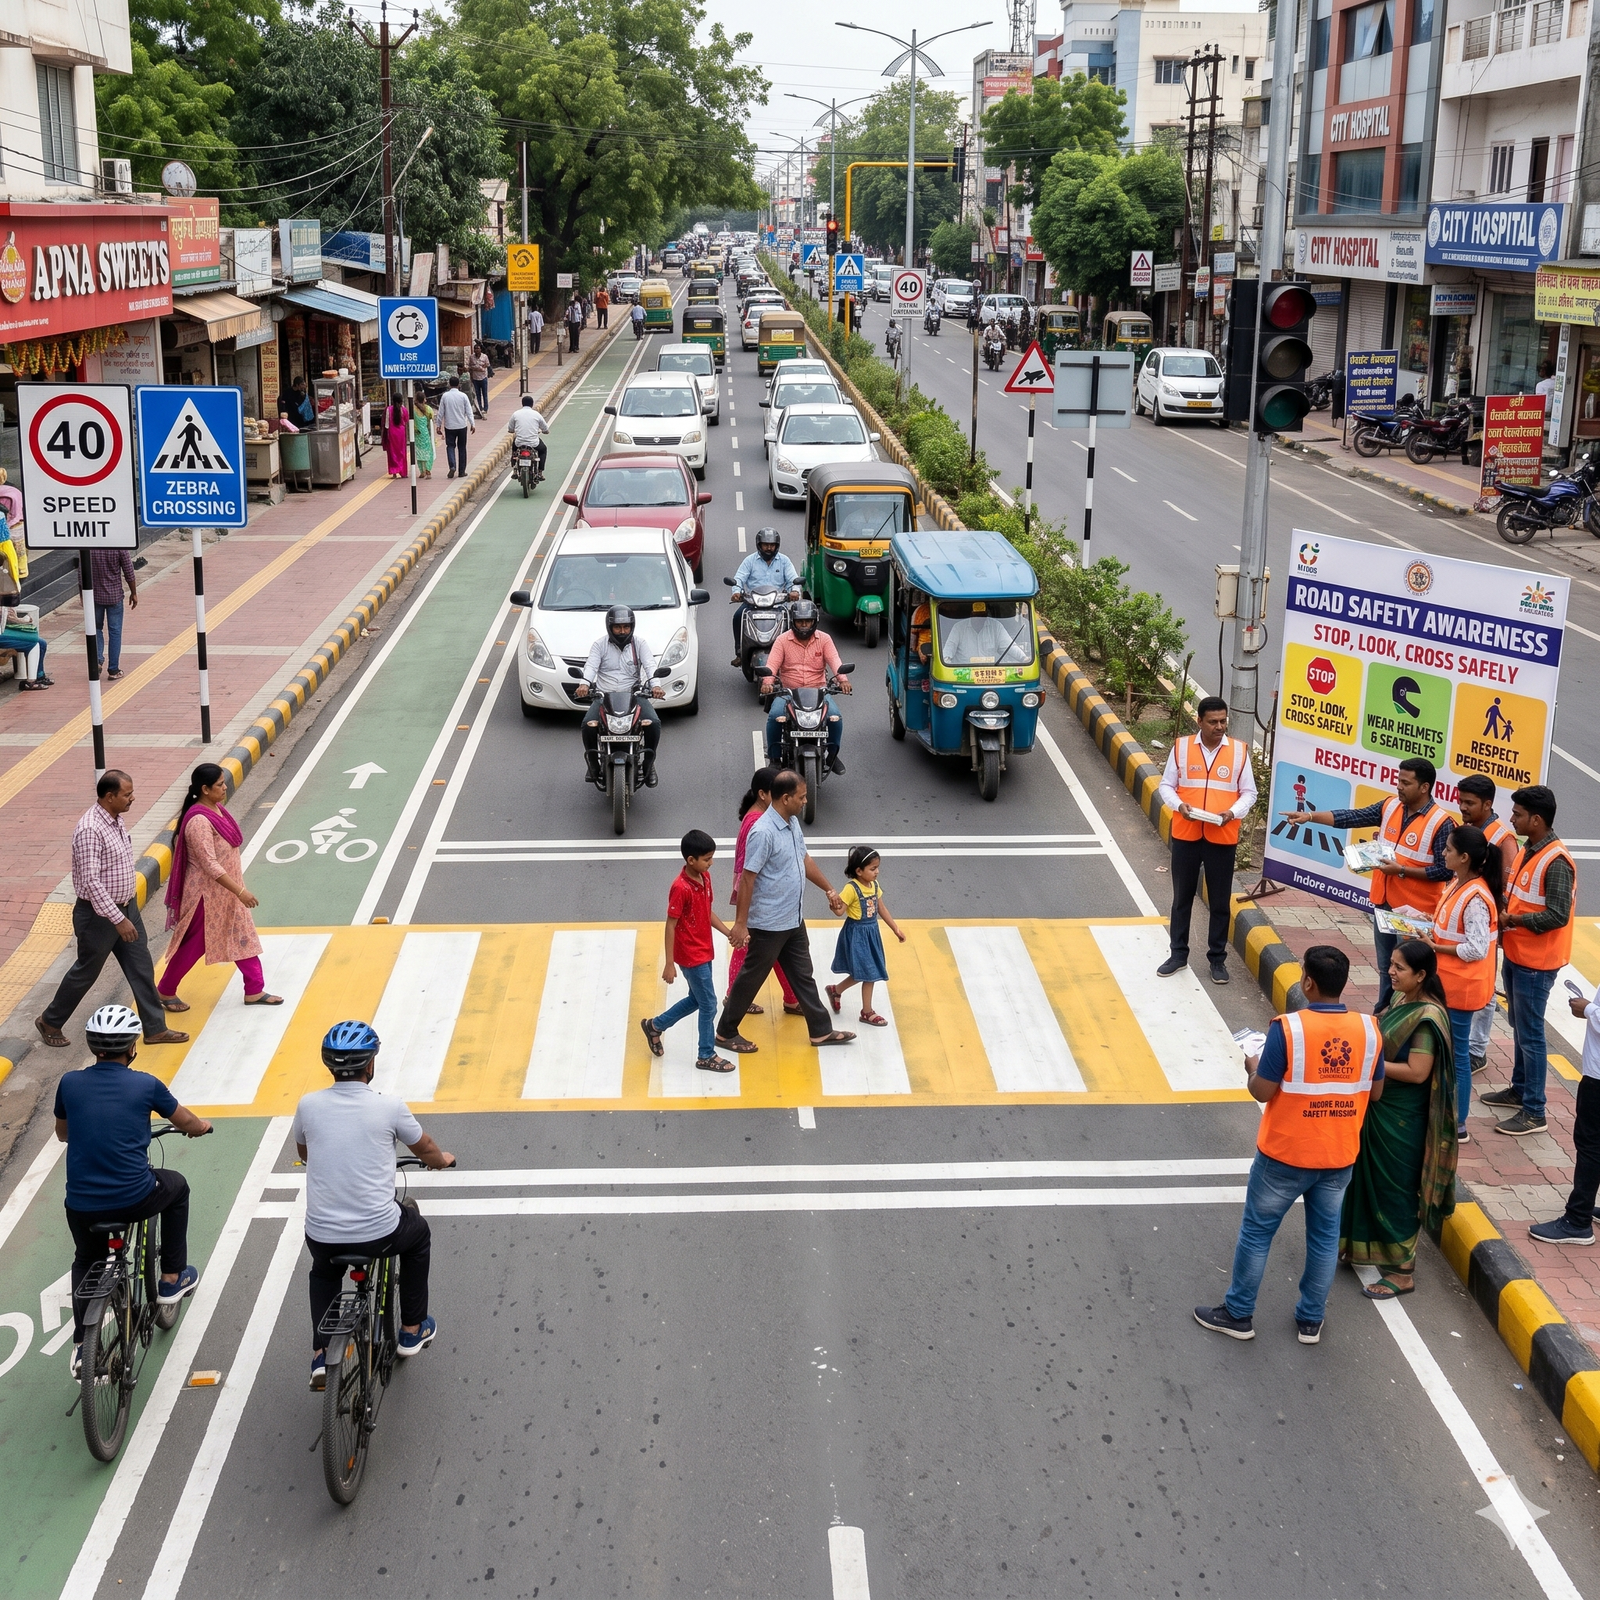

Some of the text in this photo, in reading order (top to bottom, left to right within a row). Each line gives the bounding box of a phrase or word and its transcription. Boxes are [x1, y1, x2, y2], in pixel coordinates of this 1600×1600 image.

[1331, 105, 1390, 143] CITY HOSPITAL
[1442, 210, 1536, 247] CITY HOSPITAL
[1311, 236, 1332, 265] CITY
[1333, 237, 1380, 269] HOSPITAL
[33, 243, 96, 301] APNA
[98, 240, 170, 292] SWEETS
[900, 281, 918, 293] 40
[47, 421, 105, 460] 40
[166, 480, 220, 495] ZEBRA
[43, 496, 117, 514] SPEED
[152, 500, 236, 516] CROSSING
[53, 521, 111, 538] LIMIT
[1295, 584, 1549, 657] ROAD SAFETY AWARENESS
[1314, 623, 1519, 684] STOP, LOOK, CROSS SAFELY
[1309, 667, 1335, 684] STOP
[1291, 694, 1348, 721] STOP, LOOK,
[1285, 708, 1353, 736] CROSS SAFELY
[1367, 713, 1443, 745] WEAR HELMETS
[1380, 733, 1436, 759] SEATBELTS
[1471, 740, 1519, 764] RESPECT
[1315, 747, 1377, 779] RESPECT
[1455, 753, 1531, 785] PEDESTRIANS
[1293, 871, 1352, 900] Indore road
[1329, 1109, 1357, 1118] MISSION
[1335, 1100, 1354, 1109] ROAD
